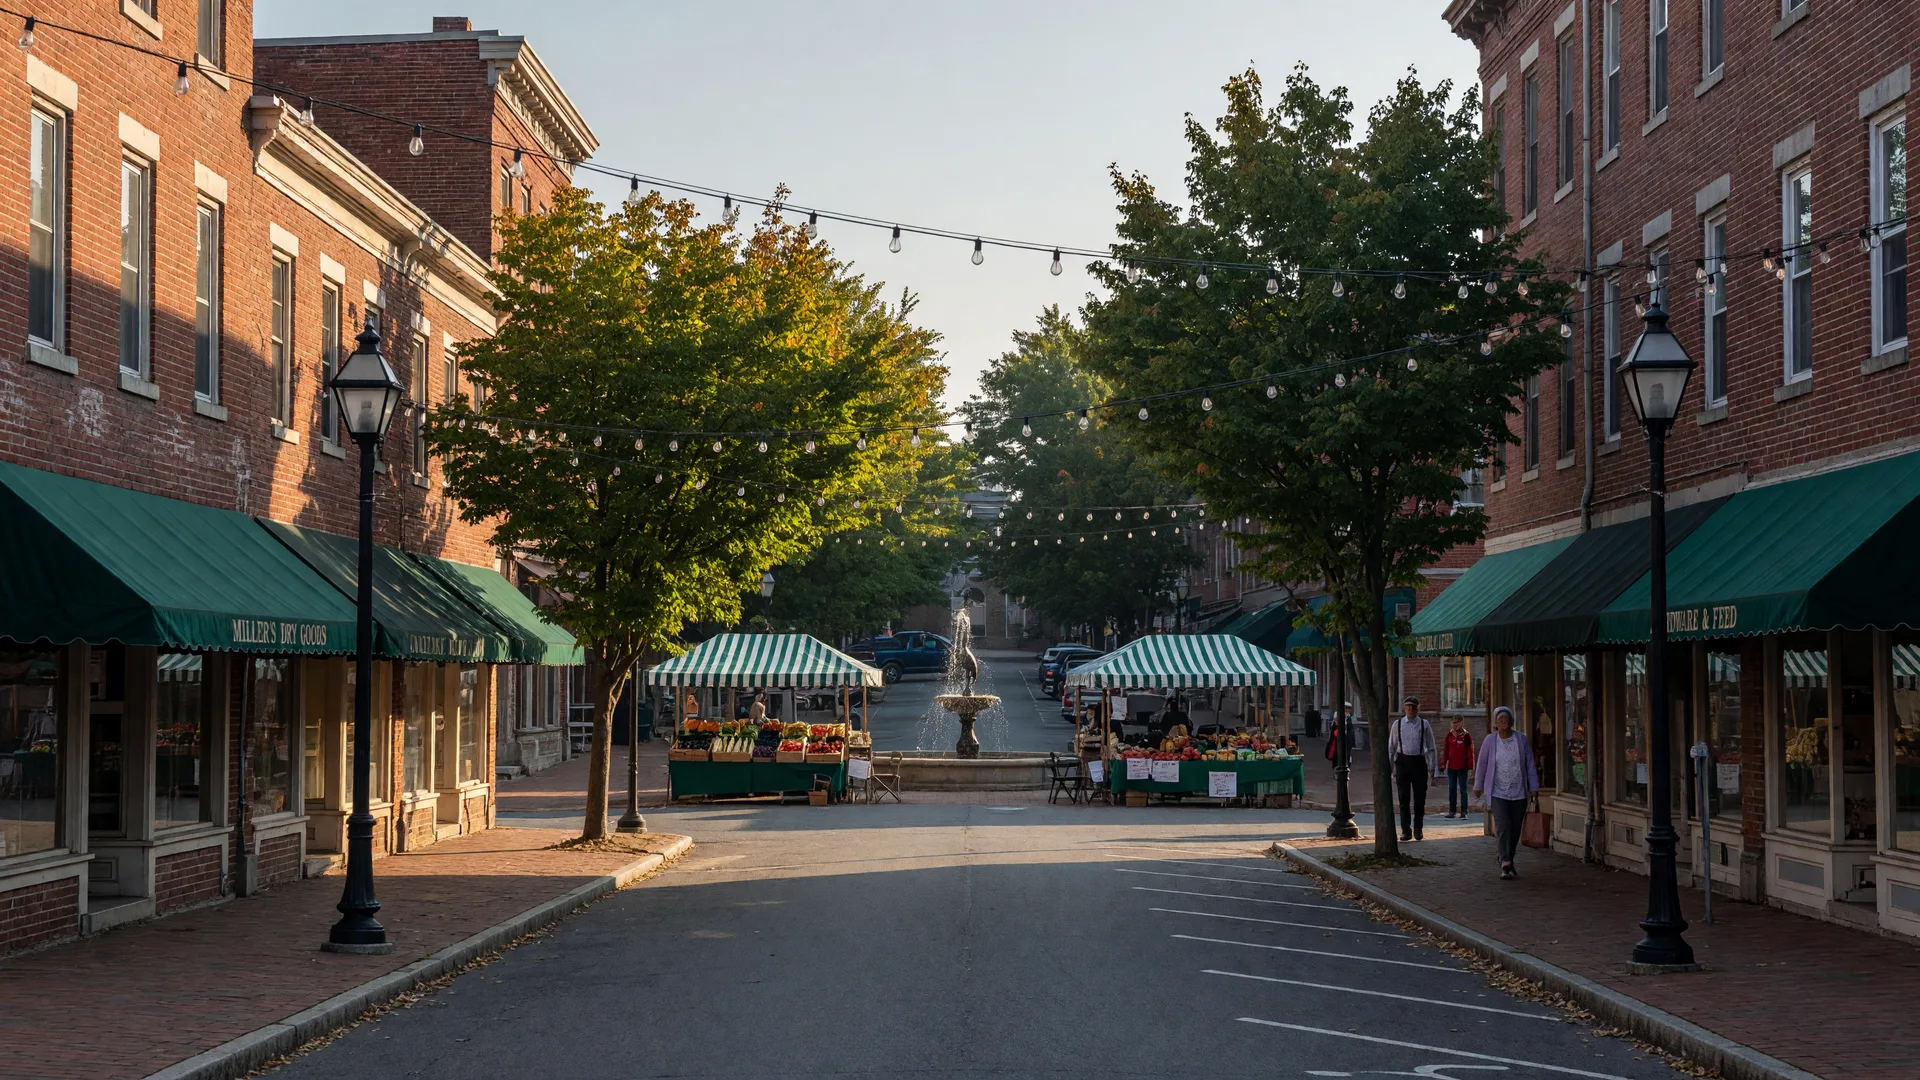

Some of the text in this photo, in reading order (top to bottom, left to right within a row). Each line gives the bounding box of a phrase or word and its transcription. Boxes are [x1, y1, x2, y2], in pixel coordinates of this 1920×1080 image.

[1702, 608, 1710, 630] &
[1712, 605, 1738, 629] FEED
[232, 619, 327, 645] MILLER'S DRY GOODS
